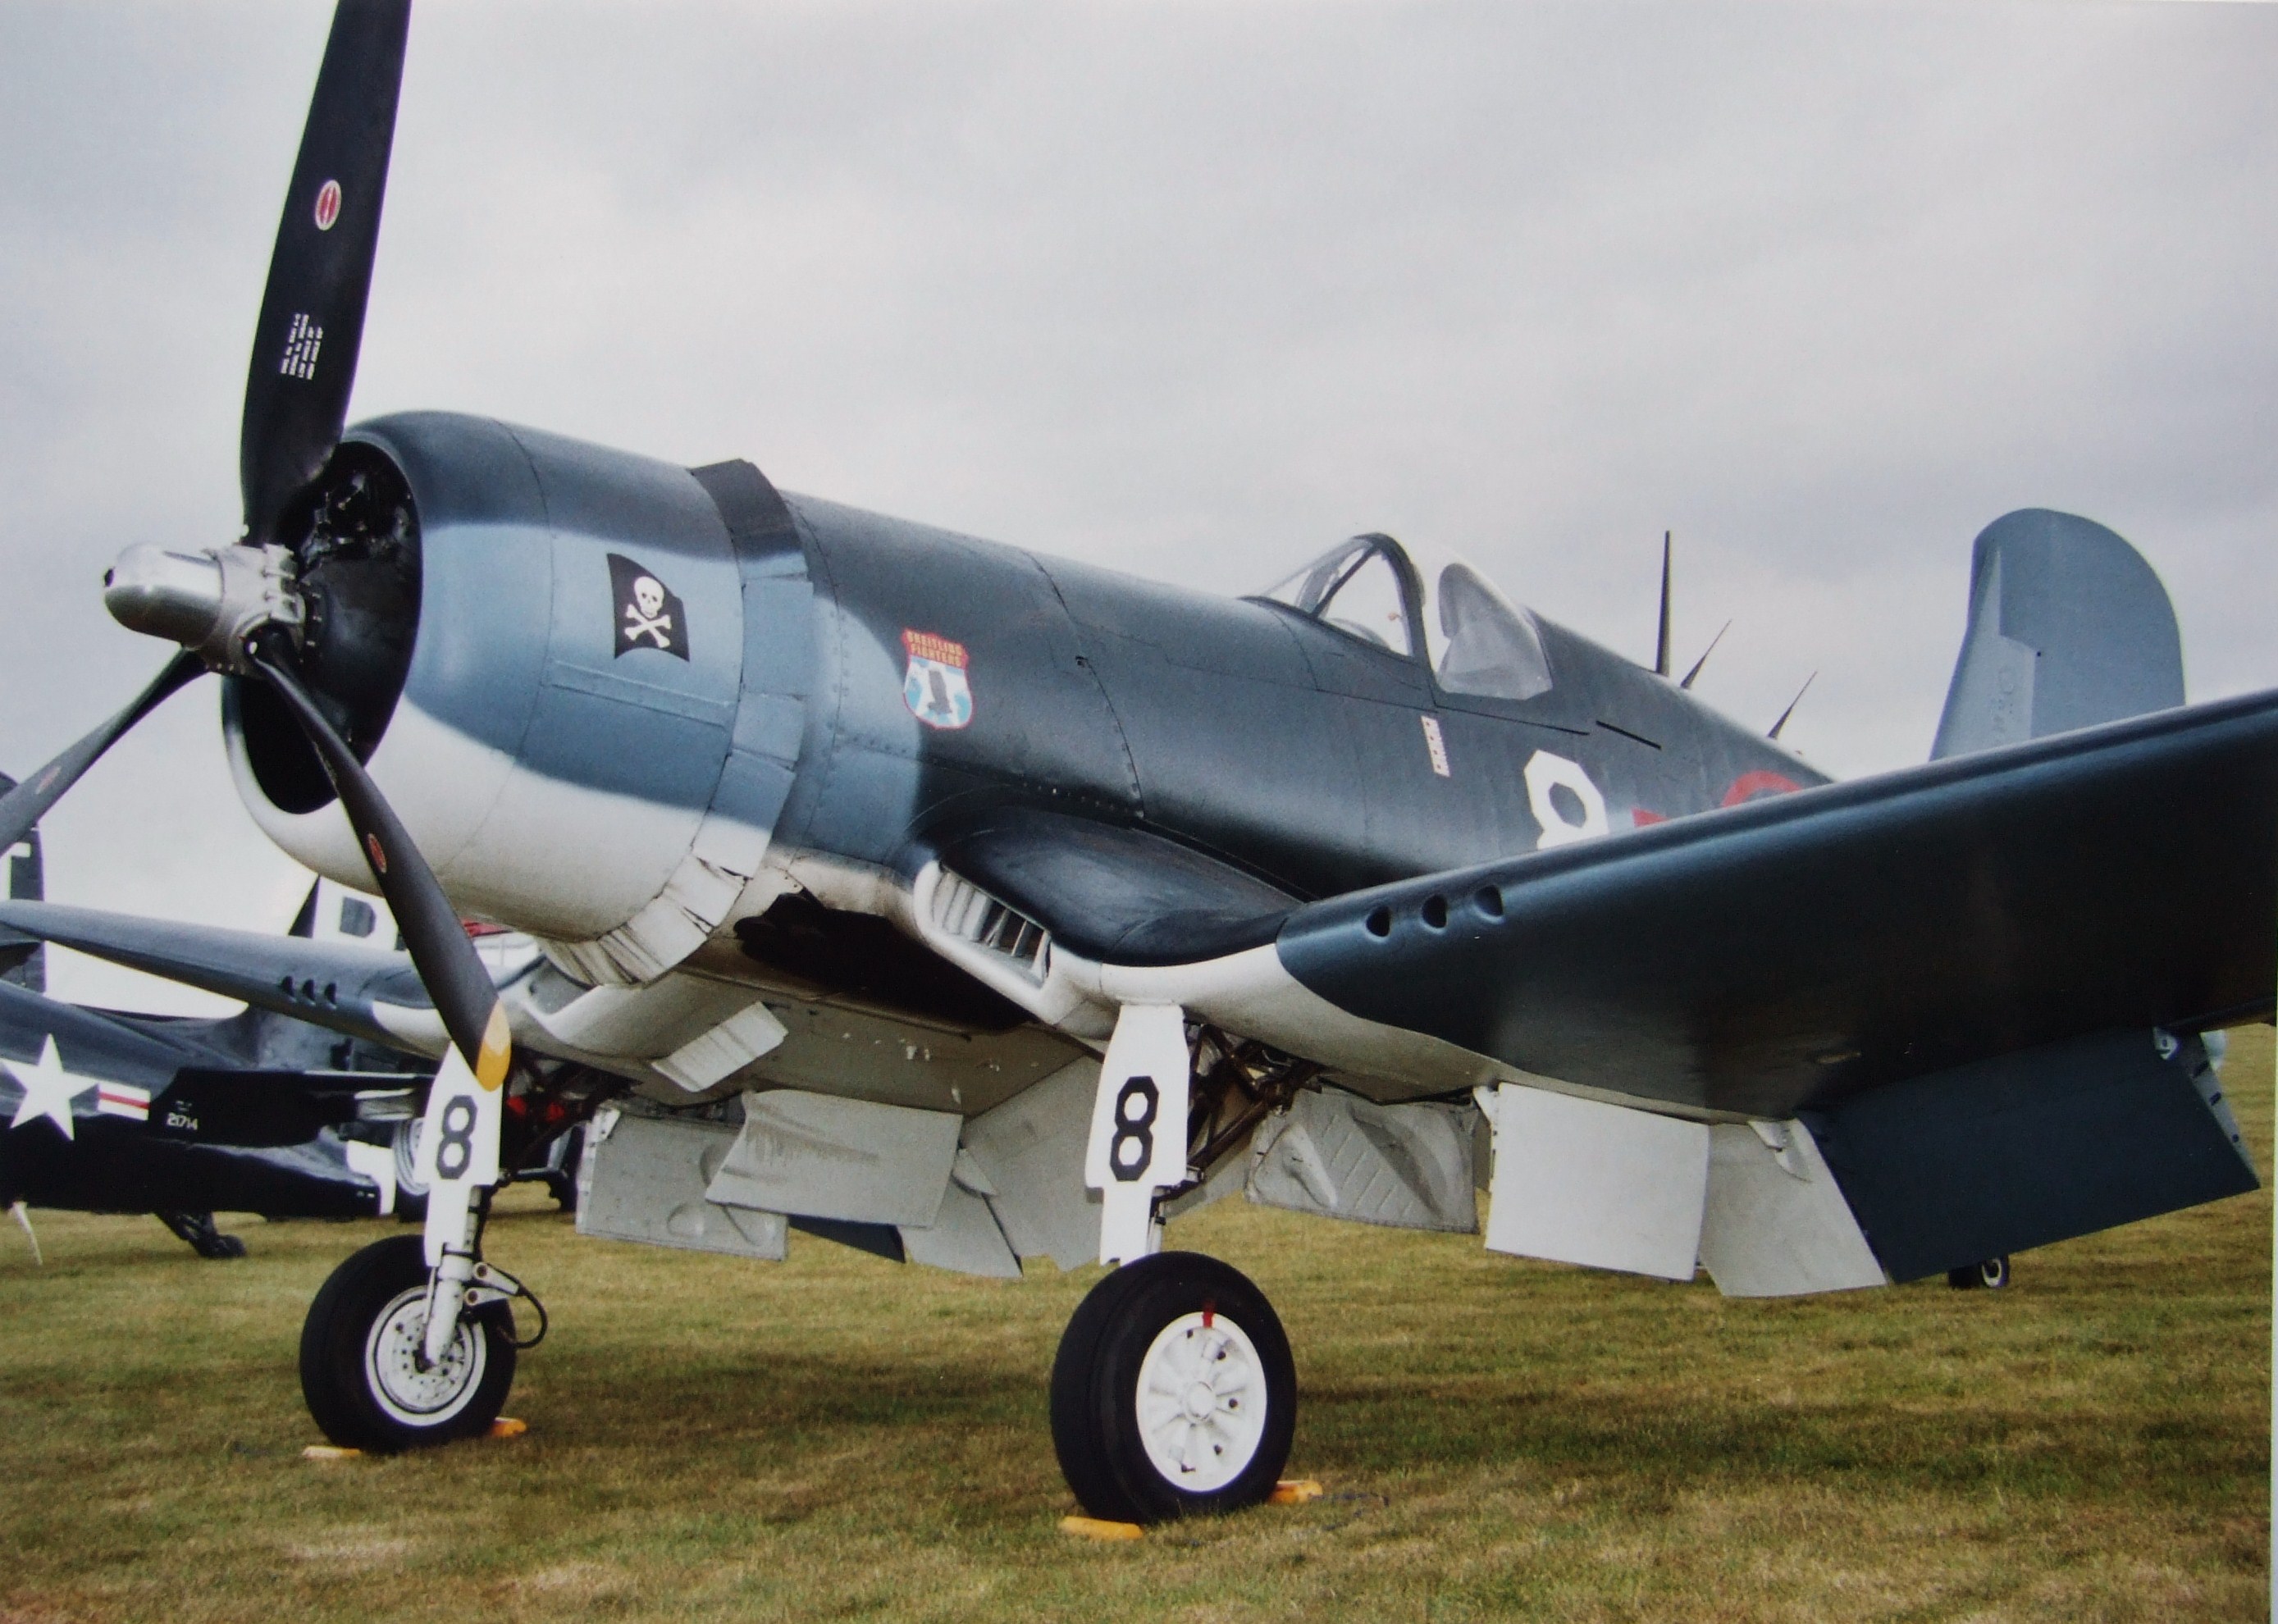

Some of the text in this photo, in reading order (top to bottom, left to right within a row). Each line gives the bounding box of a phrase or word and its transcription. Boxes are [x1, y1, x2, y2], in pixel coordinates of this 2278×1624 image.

[910, 642, 962, 668] FIGHTERS
[436, 1095, 477, 1179] 8
[1110, 1076, 1159, 1181] 8
